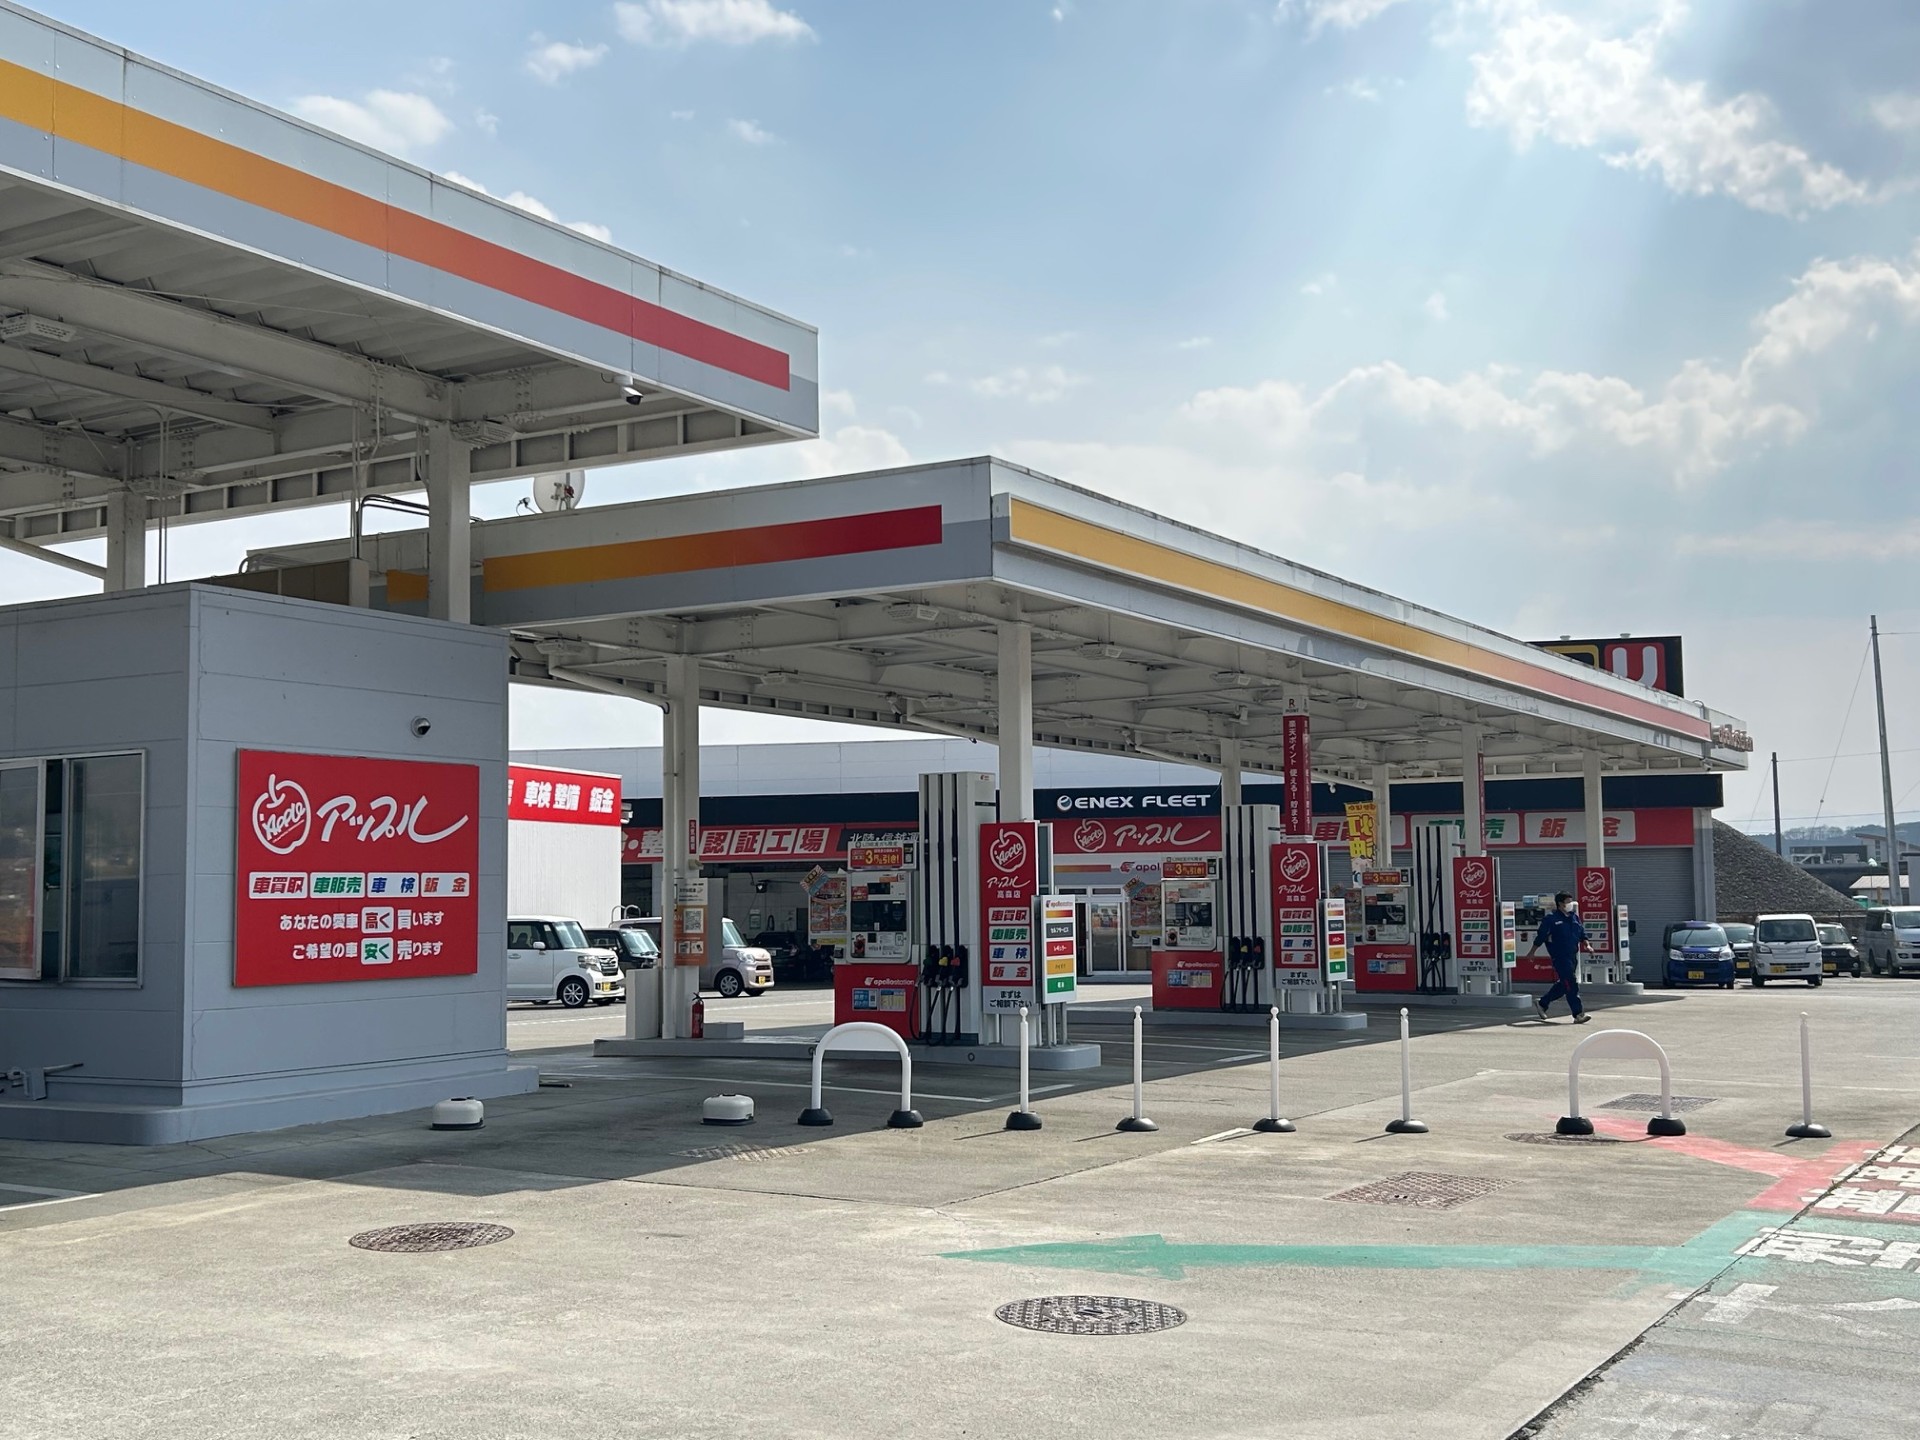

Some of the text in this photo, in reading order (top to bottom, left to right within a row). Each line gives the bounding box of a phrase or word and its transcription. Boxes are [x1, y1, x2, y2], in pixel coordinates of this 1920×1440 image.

[524, 780, 552, 807] 車検
[553, 782, 581, 811] 整備
[588, 786, 615, 813] 鈑金
[1075, 795, 1211, 809] ENEX FLEET
[316, 795, 469, 844] アップル
[1113, 822, 1211, 847] アップル
[702, 828, 828, 856] 認証工場
[253, 876, 467, 894] 車買取 車販売 車検 鈑金
[987, 876, 1031, 888] アップル
[1278, 884, 1314, 894] アップル
[280, 909, 444, 930] あなたの愛車 高く 買います
[991, 909, 1027, 921] 車買取
[992, 928, 1028, 940] 車販売
[293, 940, 443, 960] ご希望の車 安く 売ります
[992, 947, 1028, 959] 車検
[992, 966, 1029, 978] 鈑金
[1000, 990, 1022, 999] まずは
[989, 999, 1033, 1009] ご相談下さい
